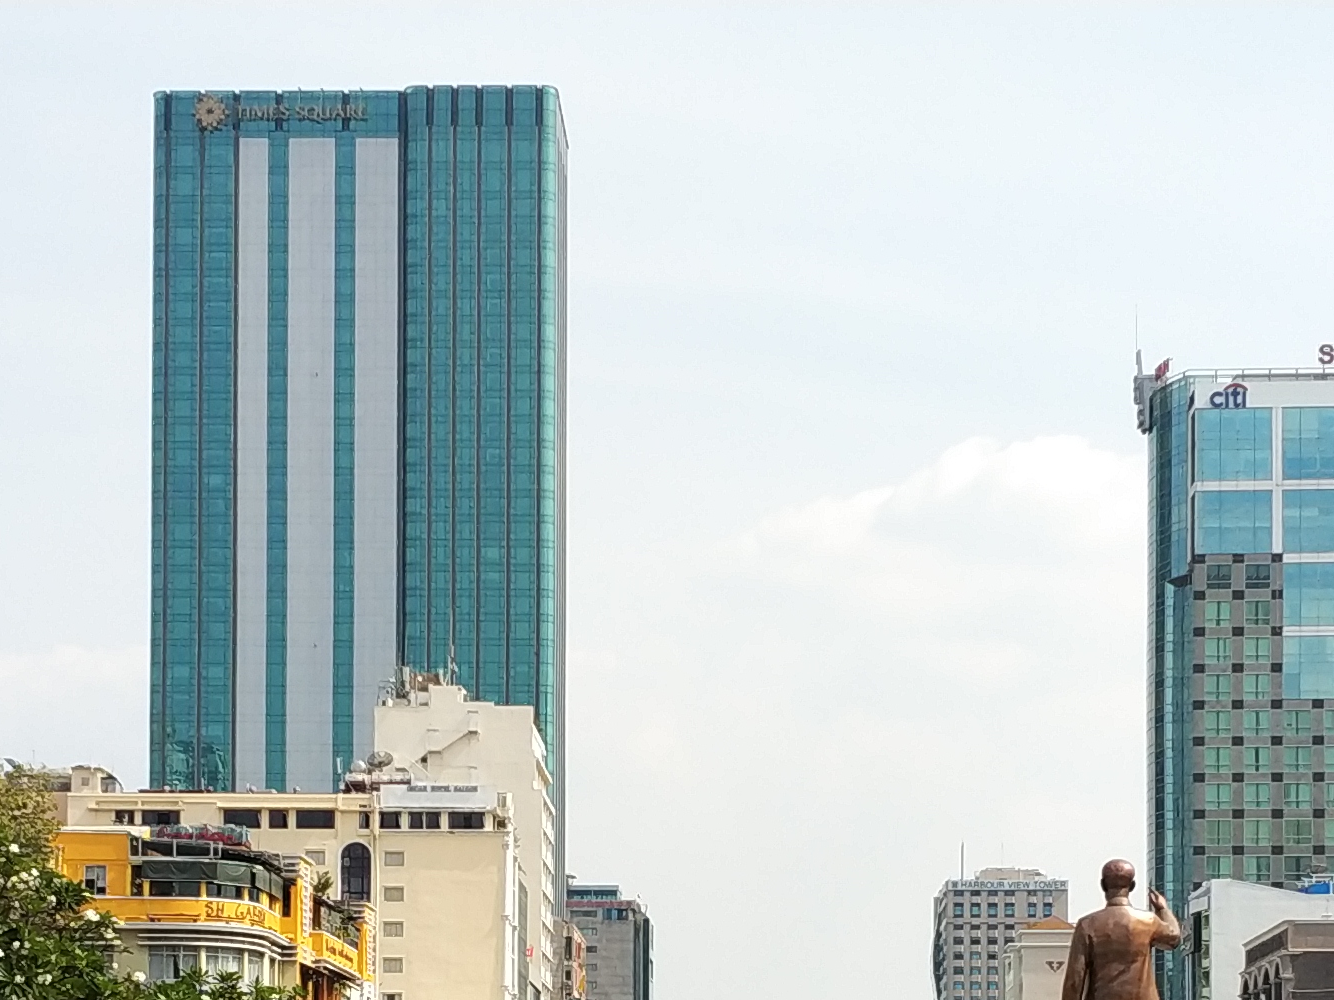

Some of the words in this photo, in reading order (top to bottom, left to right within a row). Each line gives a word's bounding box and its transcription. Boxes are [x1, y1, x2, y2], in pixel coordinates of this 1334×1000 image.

[238, 104, 290, 121] TIMES
[294, 103, 366, 123] SQUARE
[1209, 384, 1248, 409] citi
[961, 881, 1005, 889] HARBOUR
[1007, 881, 1031, 889] VIEW
[1033, 881, 1066, 889] TOWER
